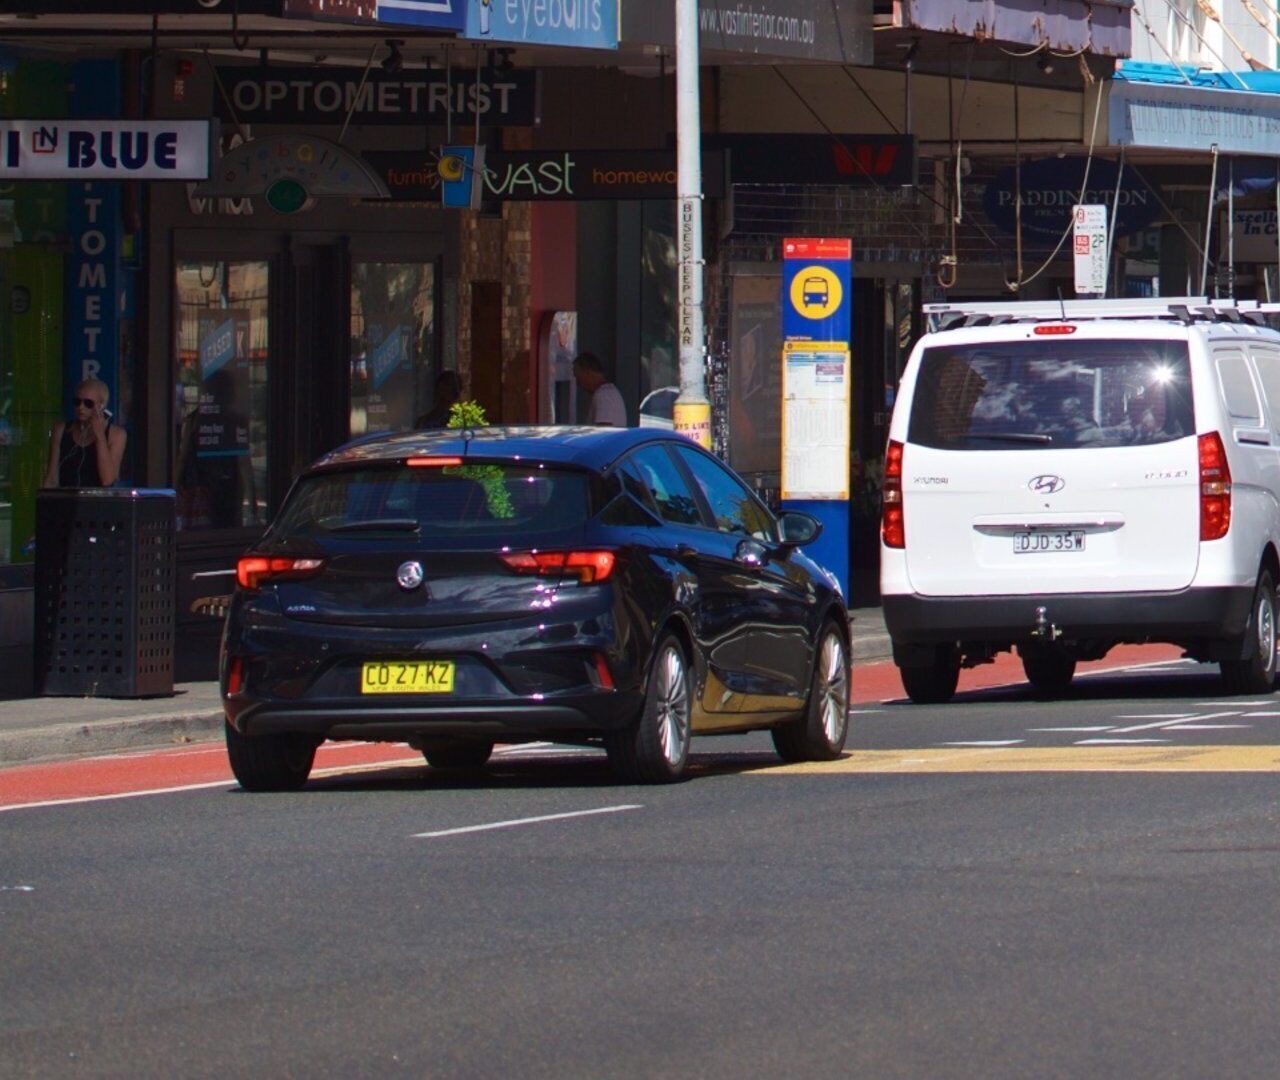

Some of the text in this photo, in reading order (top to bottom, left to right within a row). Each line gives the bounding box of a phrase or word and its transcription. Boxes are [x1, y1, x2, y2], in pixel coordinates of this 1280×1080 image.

[233, 80, 517, 114] OPTOMETRIST
[69, 131, 178, 169] BLUE
[1000, 189, 1148, 206] PADDINGTON
